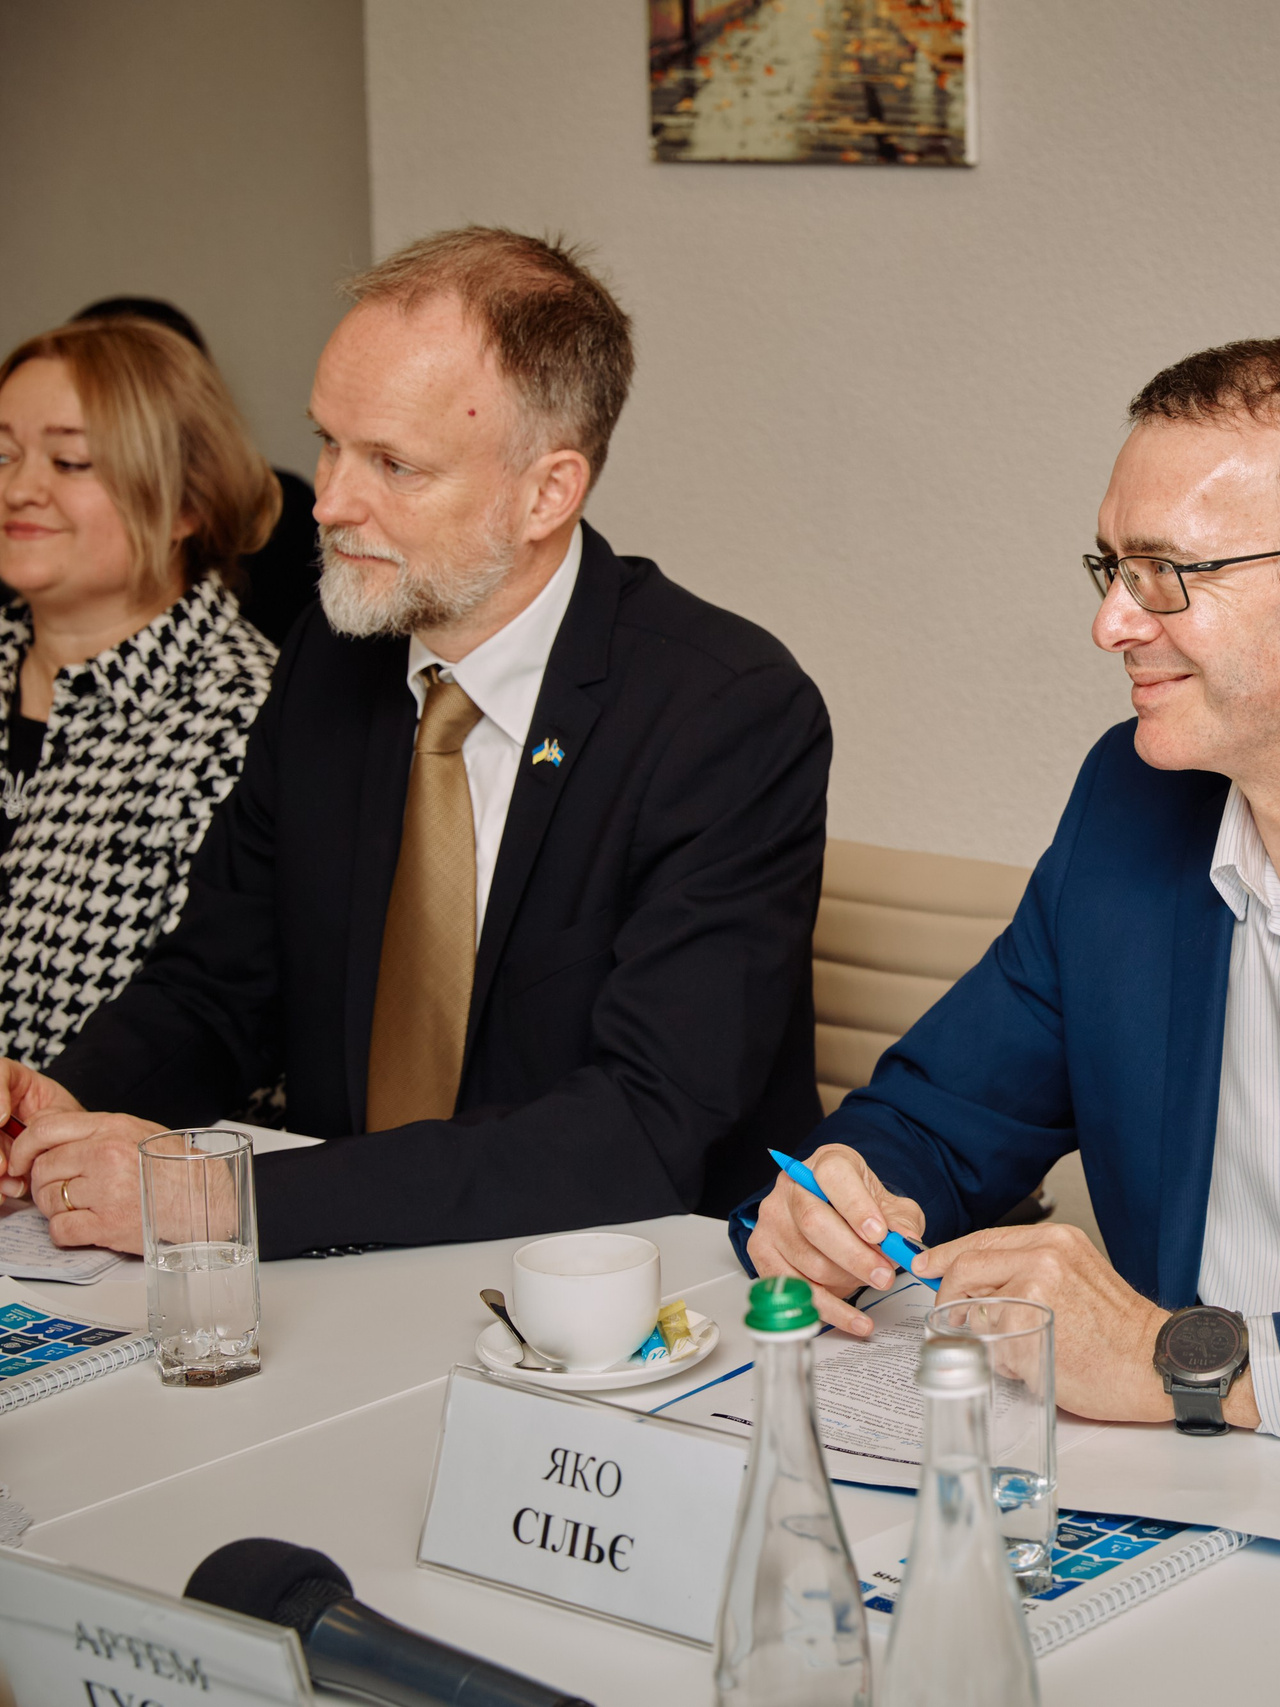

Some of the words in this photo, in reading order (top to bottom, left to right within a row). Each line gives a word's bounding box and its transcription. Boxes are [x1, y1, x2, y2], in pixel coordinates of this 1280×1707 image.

[541, 1447, 623, 1498] ЯКО
[513, 1507, 635, 1572] СІЛЬЄ
[75, 1621, 209, 1692] АРТЕМ
